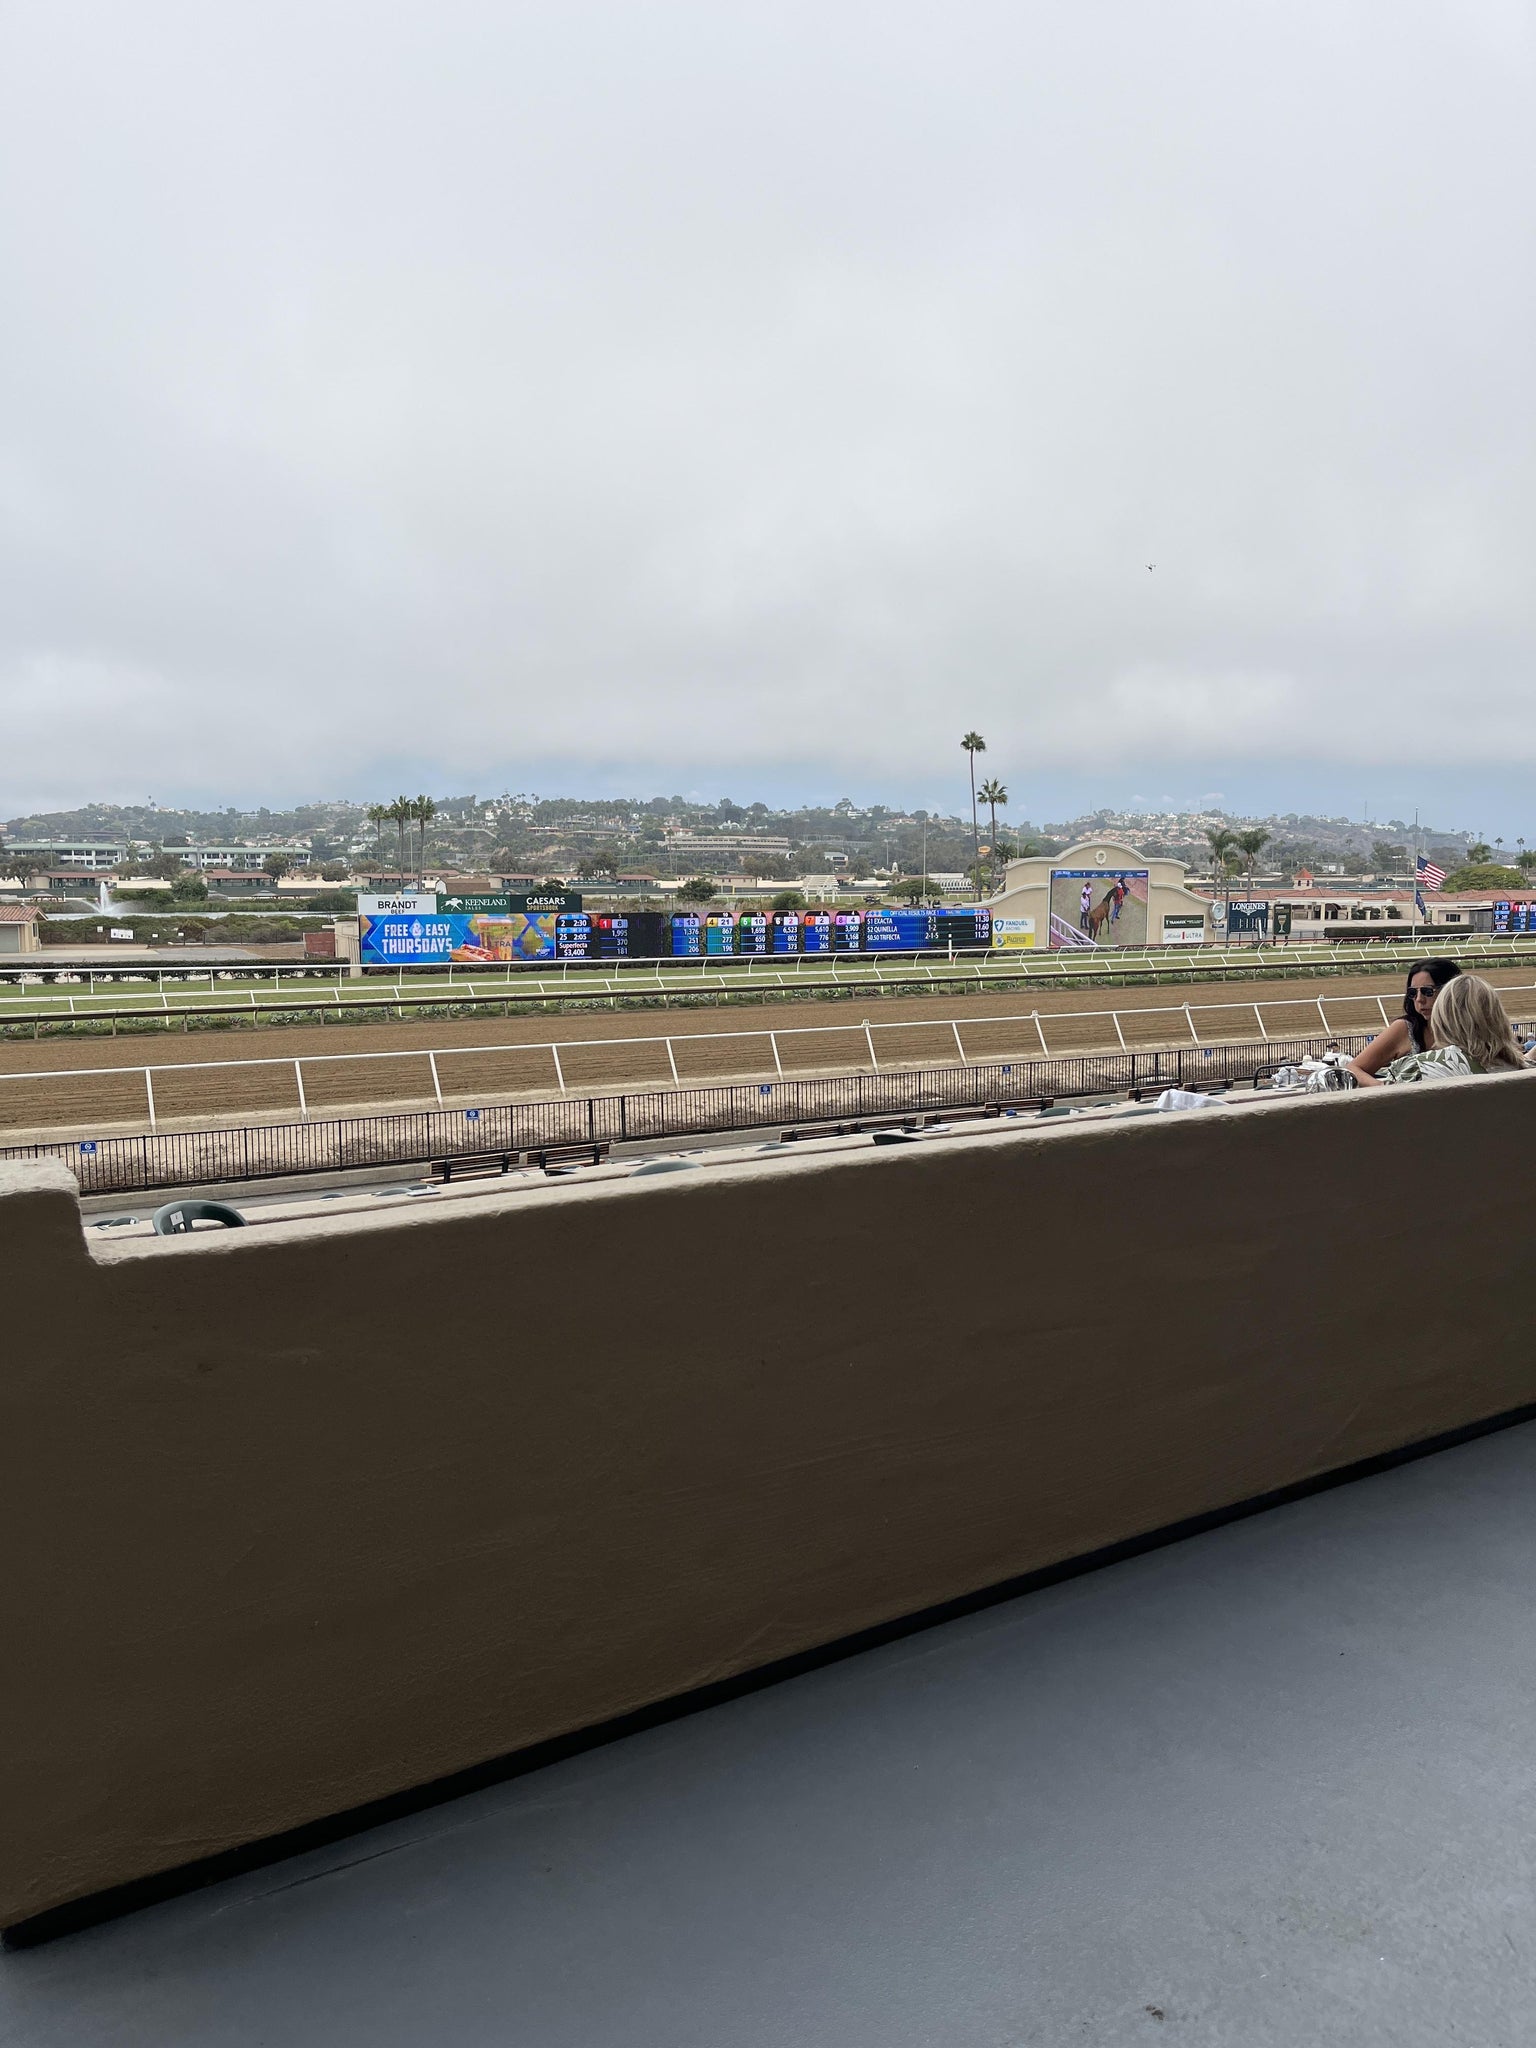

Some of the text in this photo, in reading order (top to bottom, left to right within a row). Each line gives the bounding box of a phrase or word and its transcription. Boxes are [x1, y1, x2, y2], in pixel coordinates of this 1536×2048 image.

[378, 901, 417, 909] BRANDT
[526, 897, 566, 905] CAESARS
[384, 923, 450, 936] FREE & EASY
[382, 938, 452, 954] THURSDAYS
